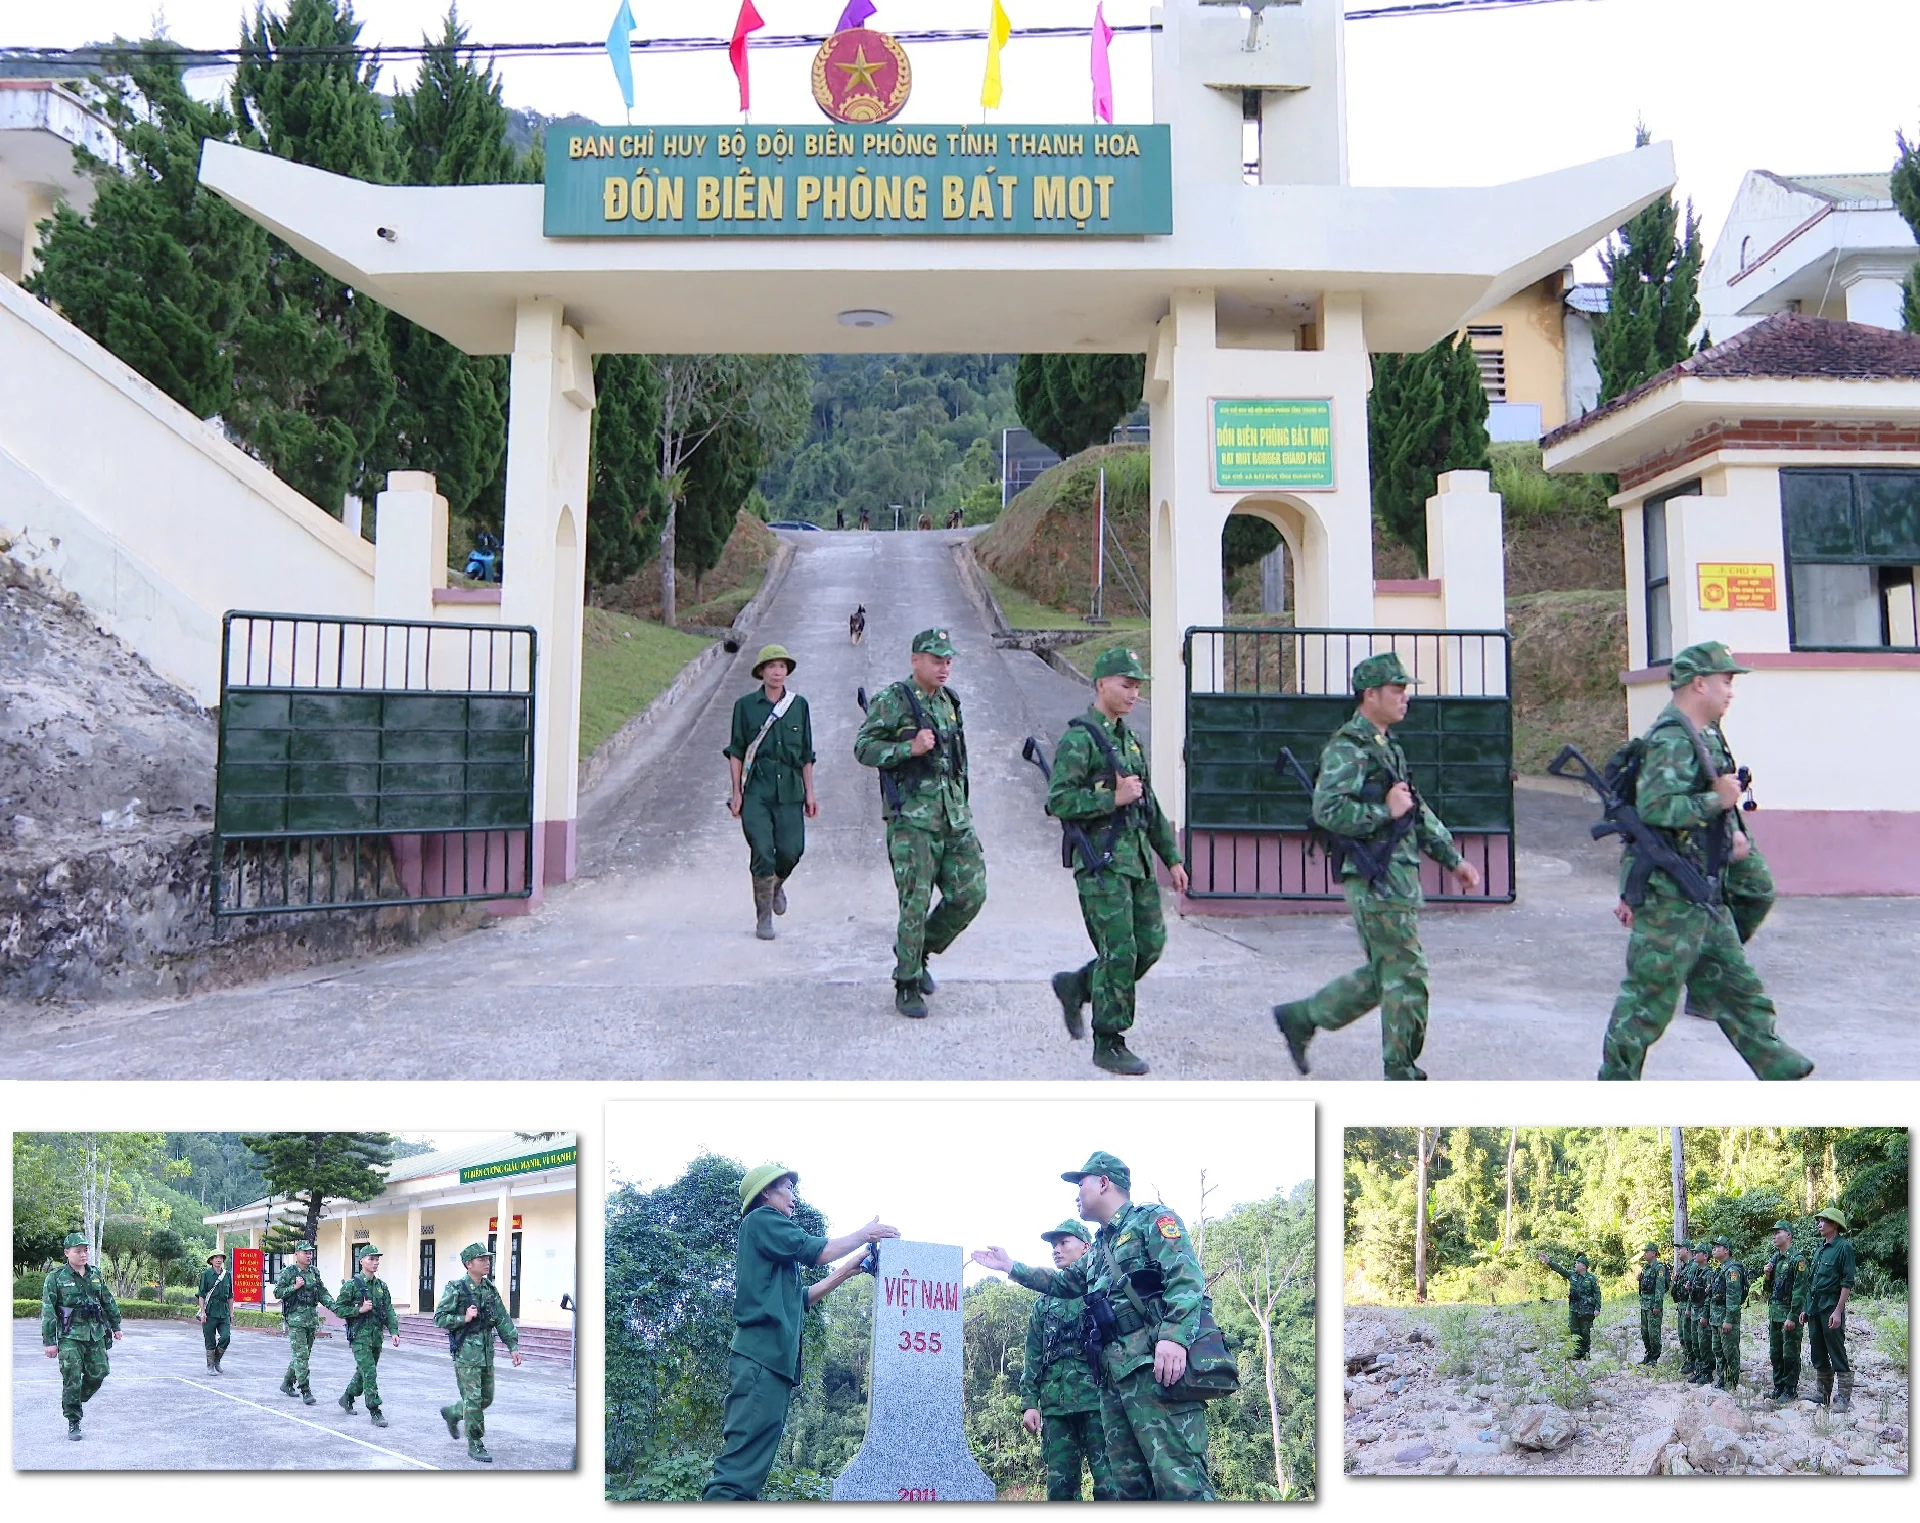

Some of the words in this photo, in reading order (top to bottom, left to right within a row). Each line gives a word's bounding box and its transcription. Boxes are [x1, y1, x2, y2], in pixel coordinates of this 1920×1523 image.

[569, 135, 613, 158] BAN
[664, 135, 707, 157] HUY
[718, 128, 746, 163] BỘ
[756, 128, 794, 163] ĐỘI
[805, 127, 854, 157] BIÊN
[863, 128, 937, 157] PHÒNG
[1007, 133, 1084, 157] THANH
[697, 167, 783, 221] BIÊN
[797, 166, 927, 221] PHÒNG
[942, 166, 1018, 221] BÁT
[1033, 175, 1114, 229] MỌT
[884, 1268, 917, 1316] VIỆT
[921, 1279, 958, 1311] NAM
[897, 1331, 942, 1353] 355
[897, 1487, 936, 1501] 2011
